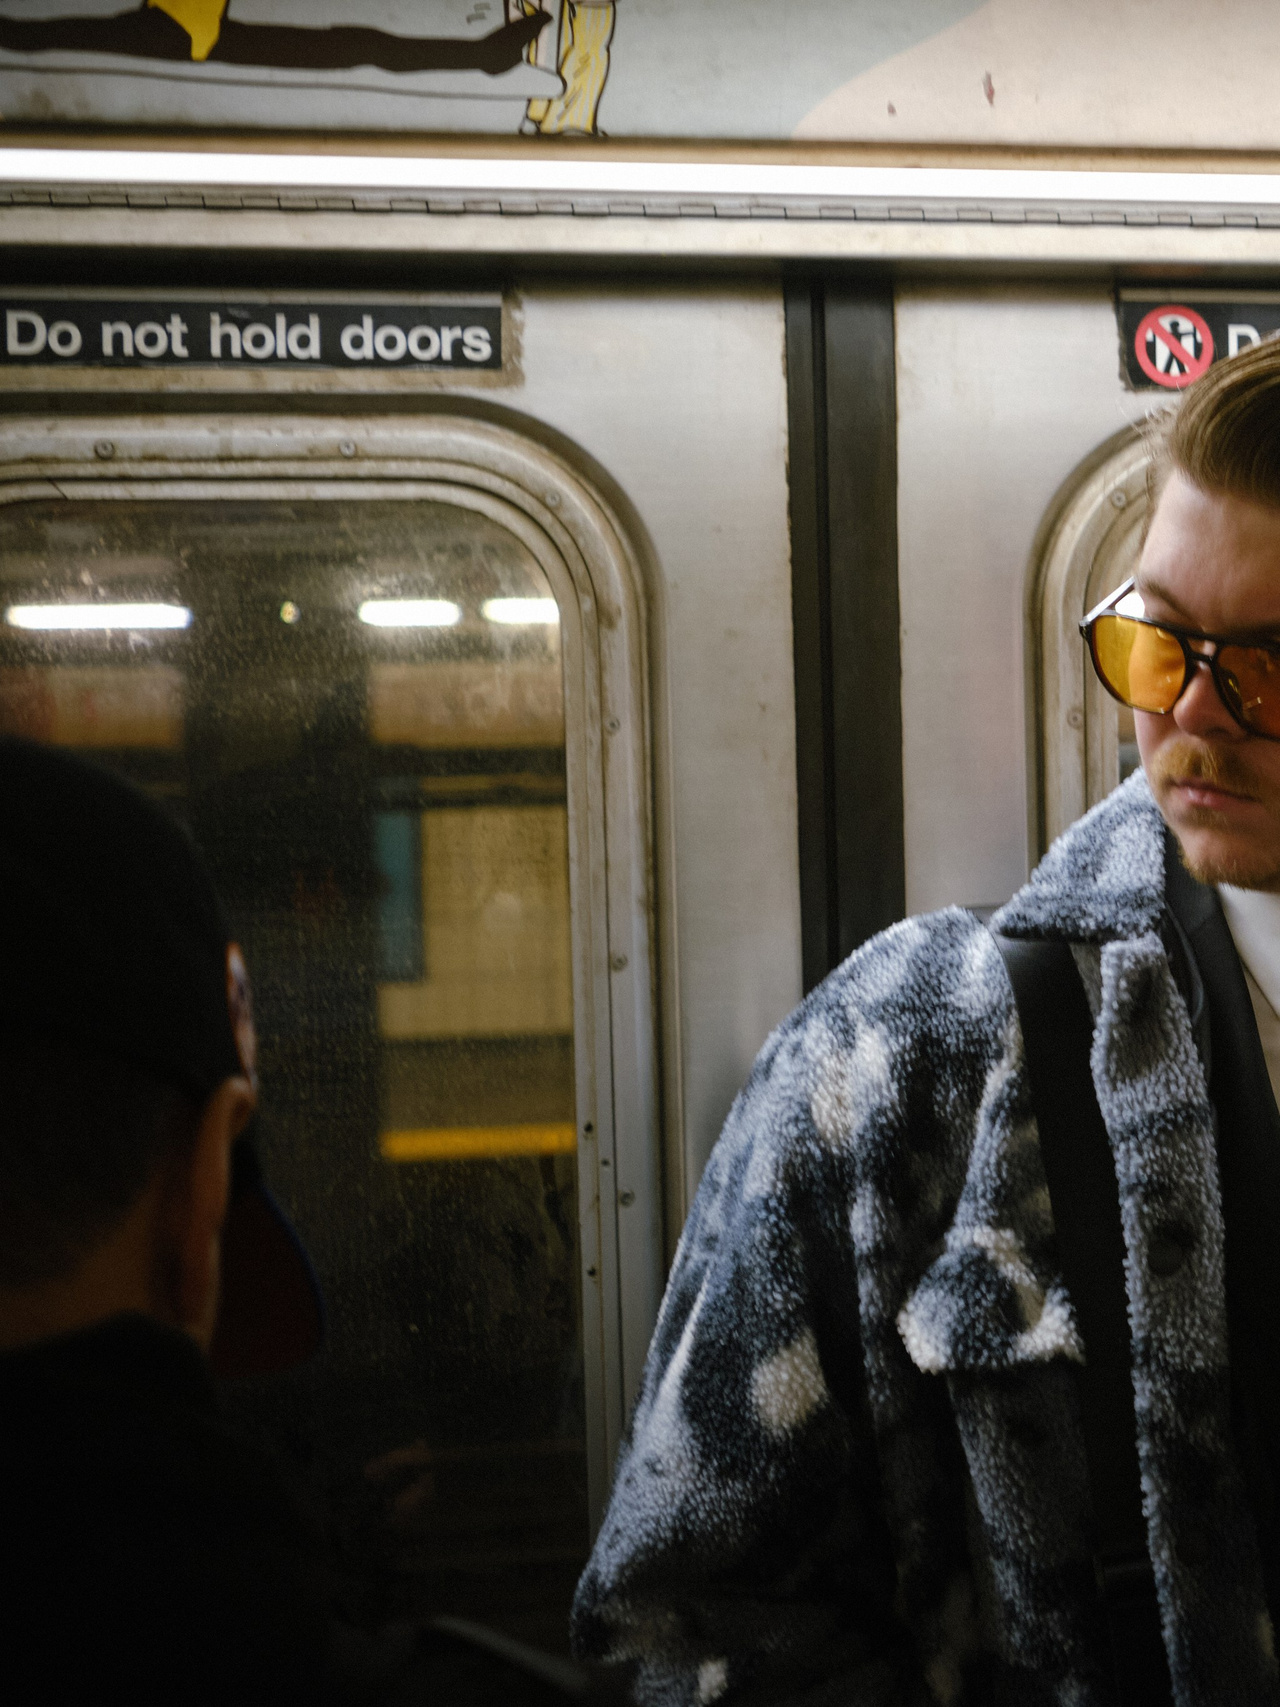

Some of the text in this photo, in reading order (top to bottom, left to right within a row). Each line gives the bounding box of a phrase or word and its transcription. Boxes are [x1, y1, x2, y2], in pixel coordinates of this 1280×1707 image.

[6, 310, 493, 361] Do not hold doors
